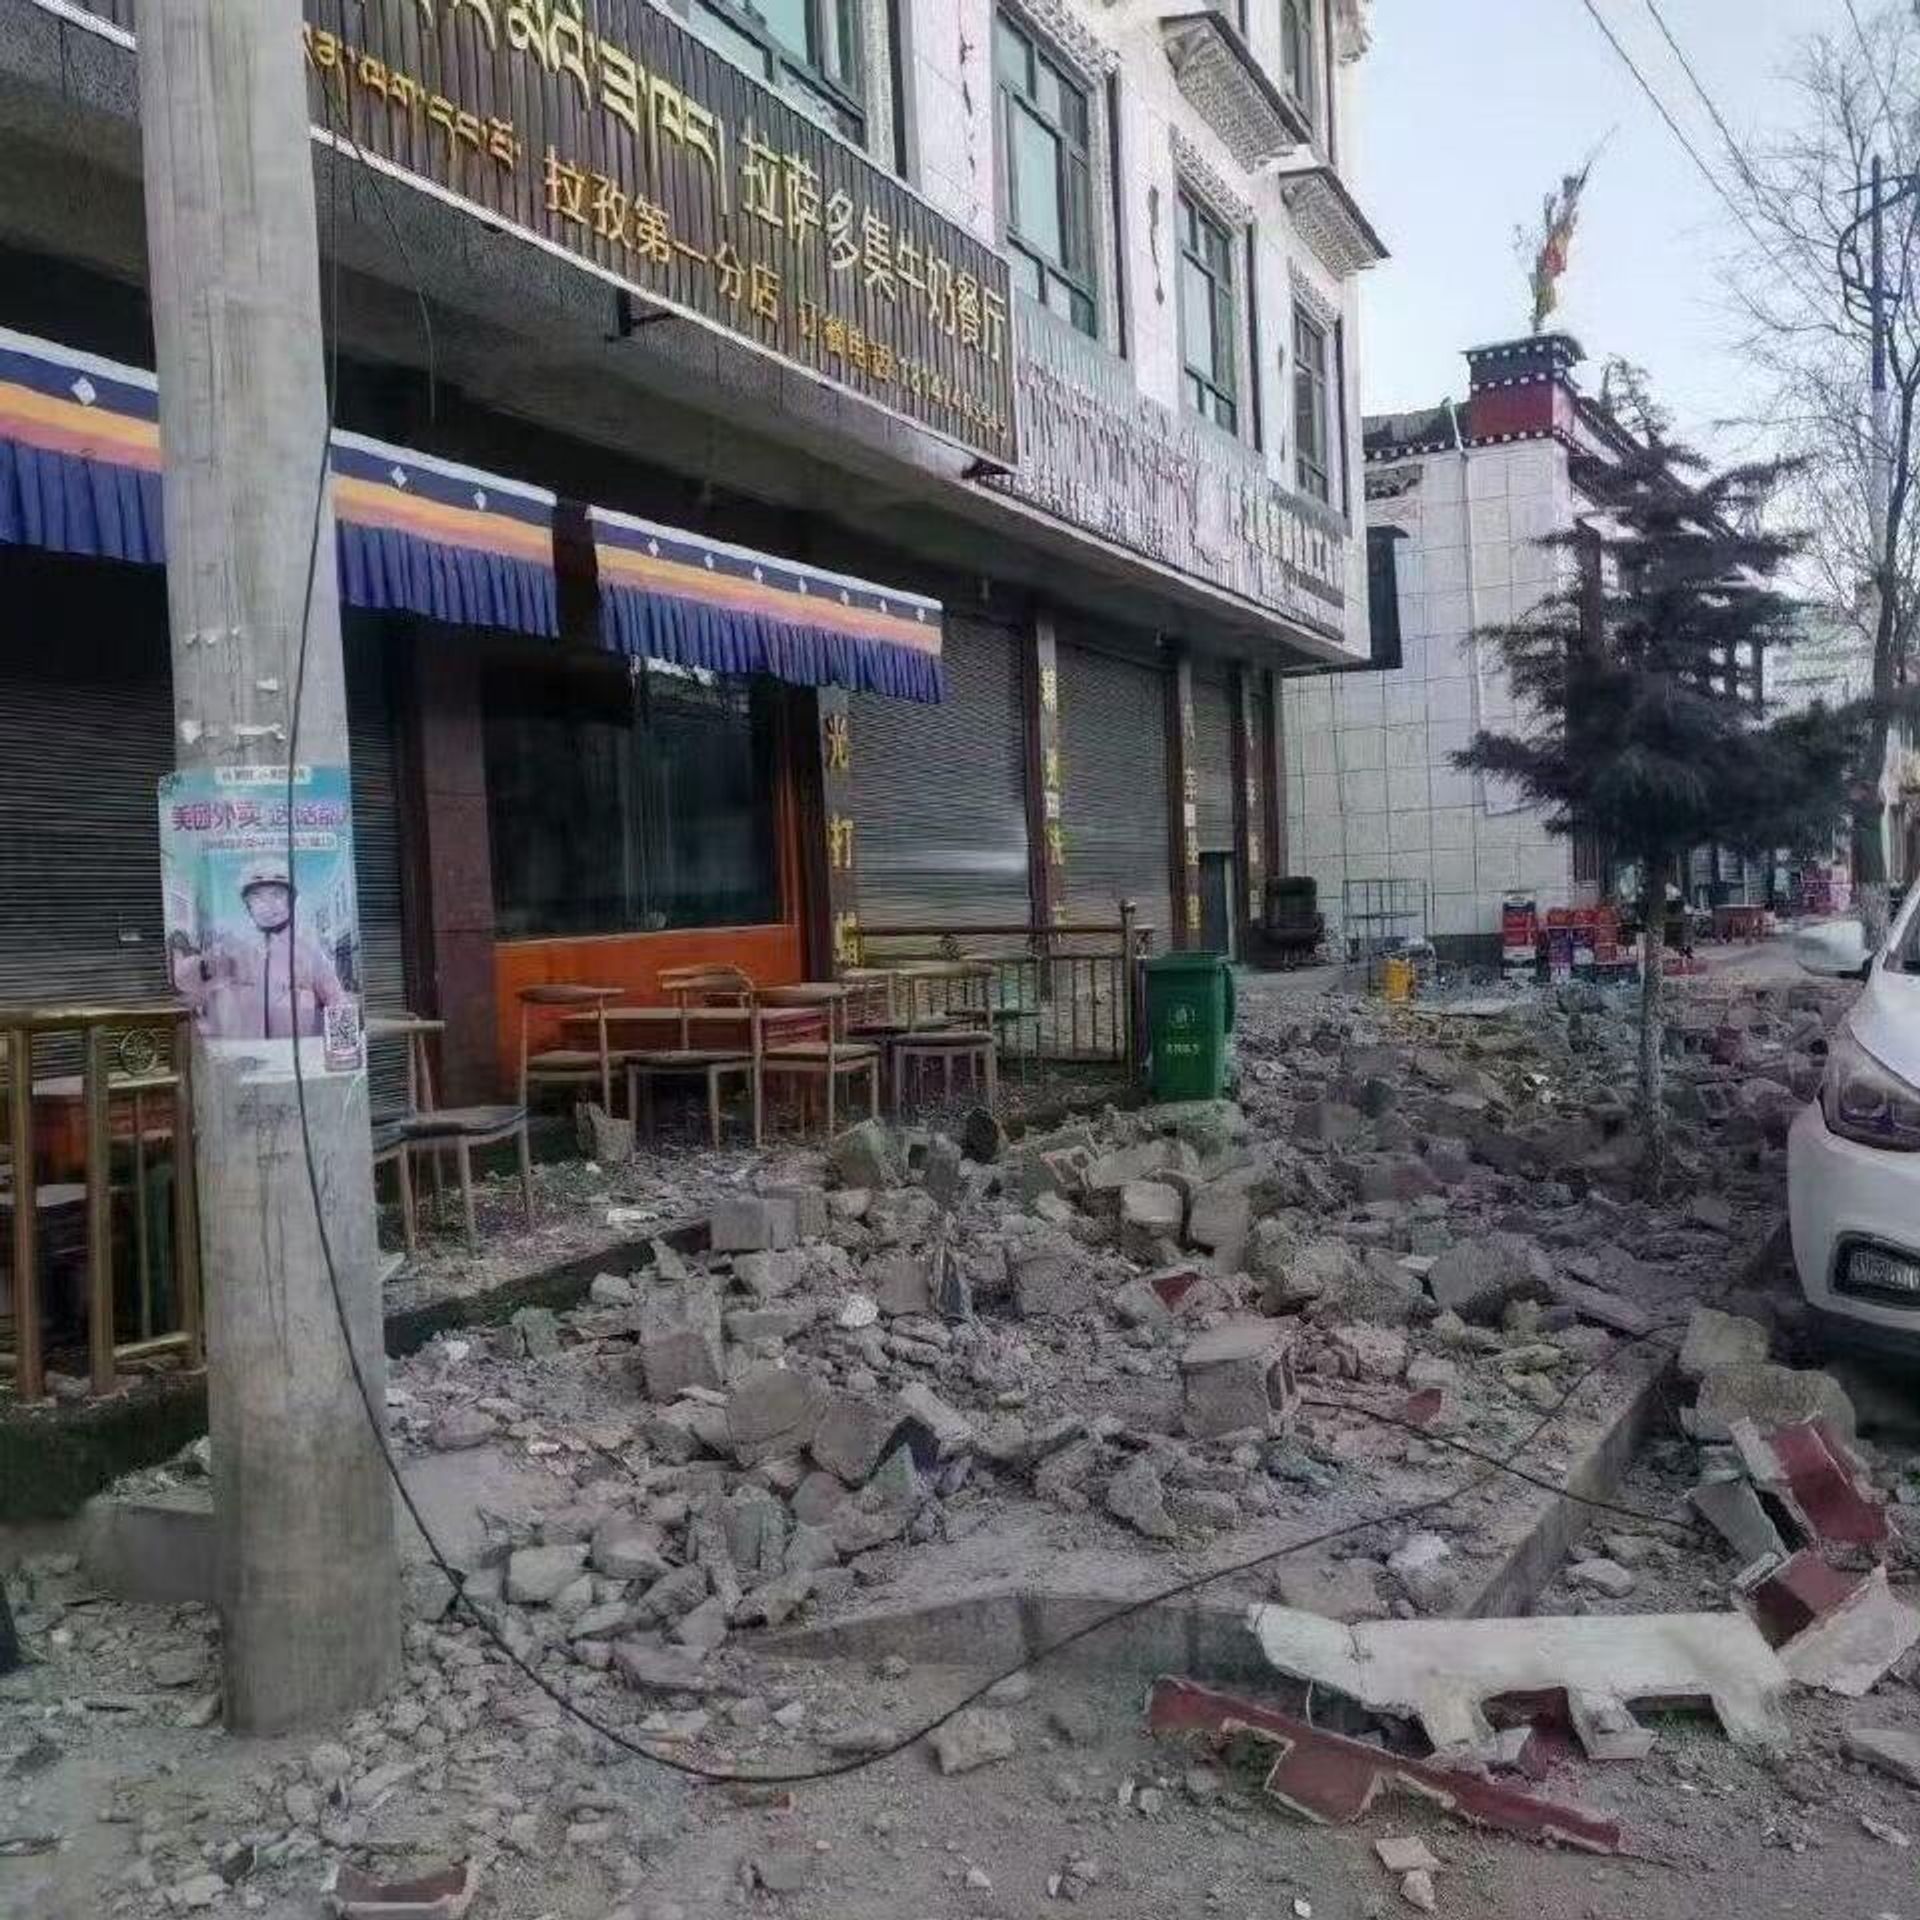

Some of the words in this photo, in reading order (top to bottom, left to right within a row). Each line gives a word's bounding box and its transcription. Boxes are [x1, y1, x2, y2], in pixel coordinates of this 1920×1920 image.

[544, 145, 782, 324] 拉孜第一分店
